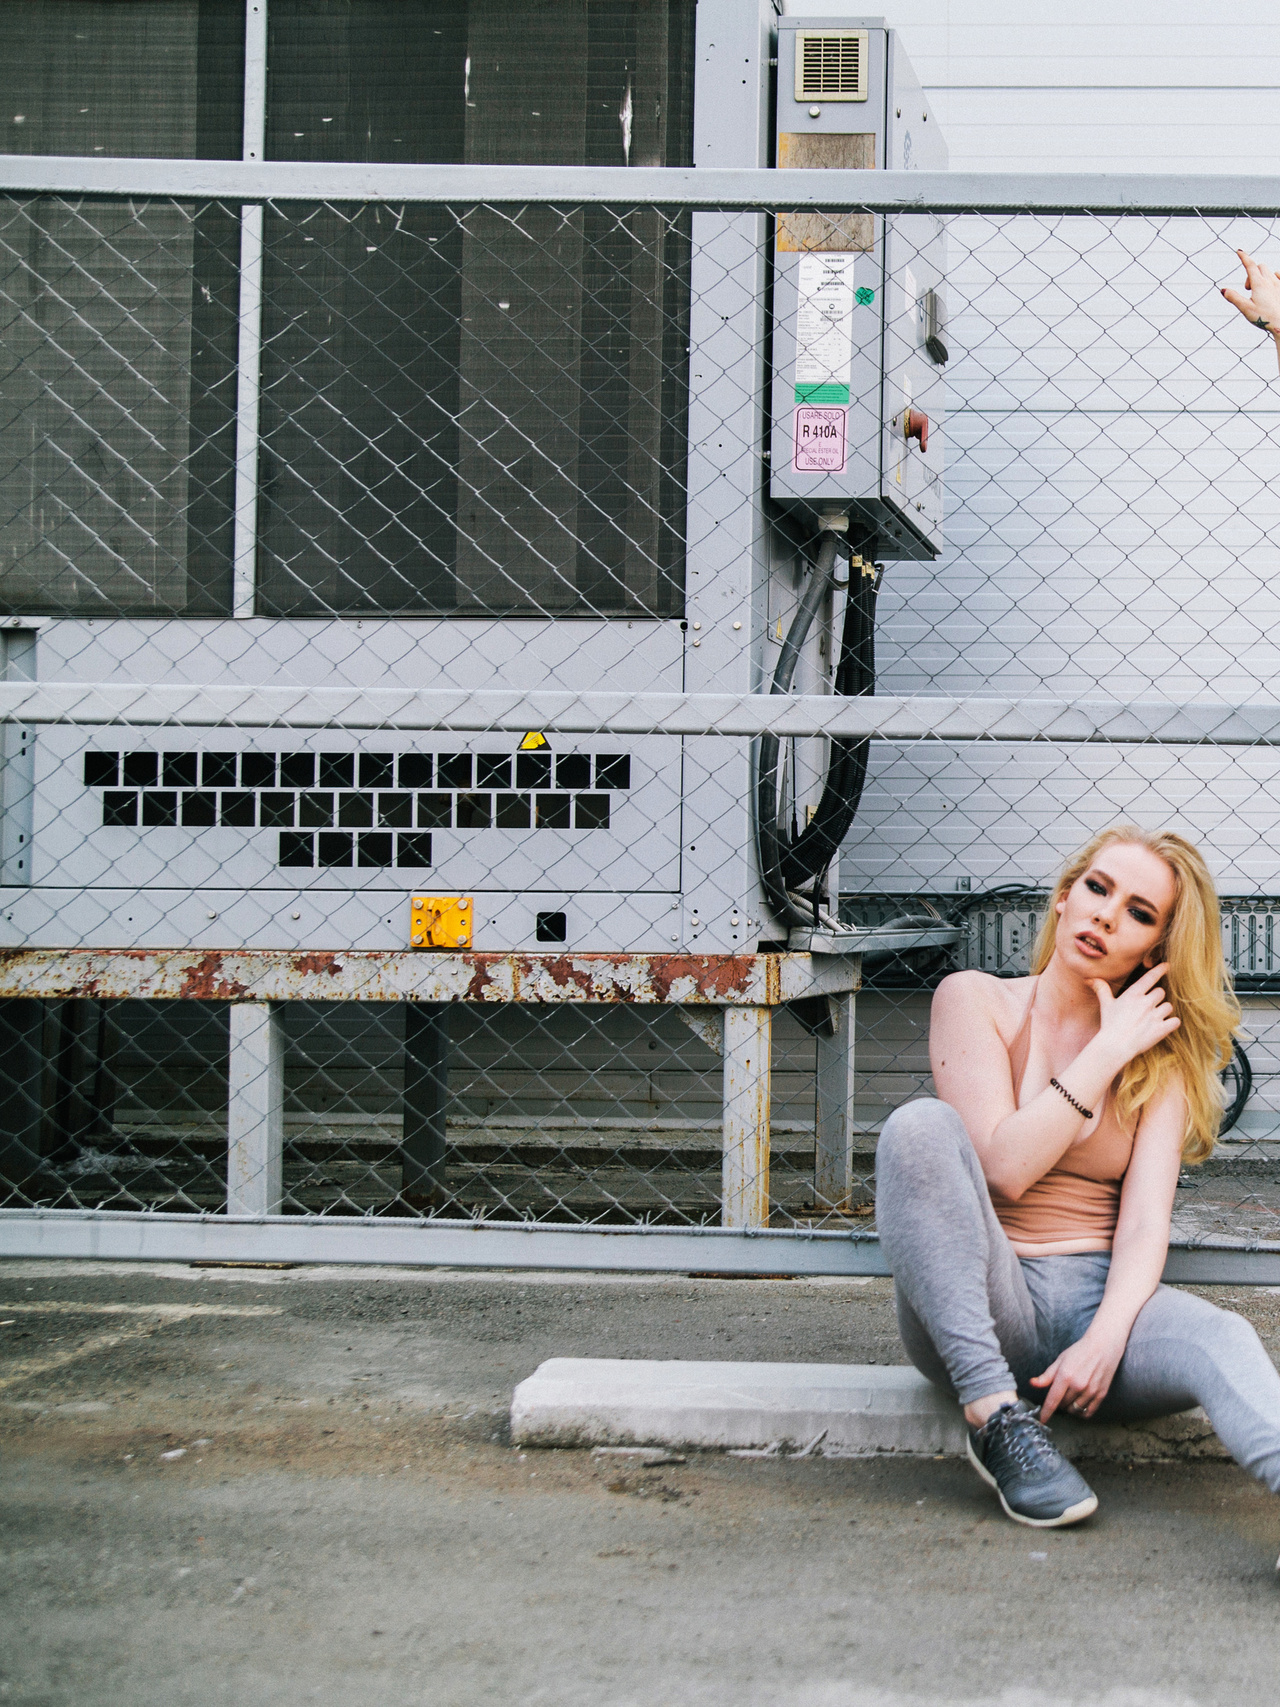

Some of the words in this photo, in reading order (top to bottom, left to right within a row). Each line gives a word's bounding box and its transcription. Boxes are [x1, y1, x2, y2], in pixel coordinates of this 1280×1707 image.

[802, 411, 823, 419] USARE
[824, 411, 840, 419] SOLO
[803, 425, 810, 438] R
[813, 425, 837, 438] 410A
